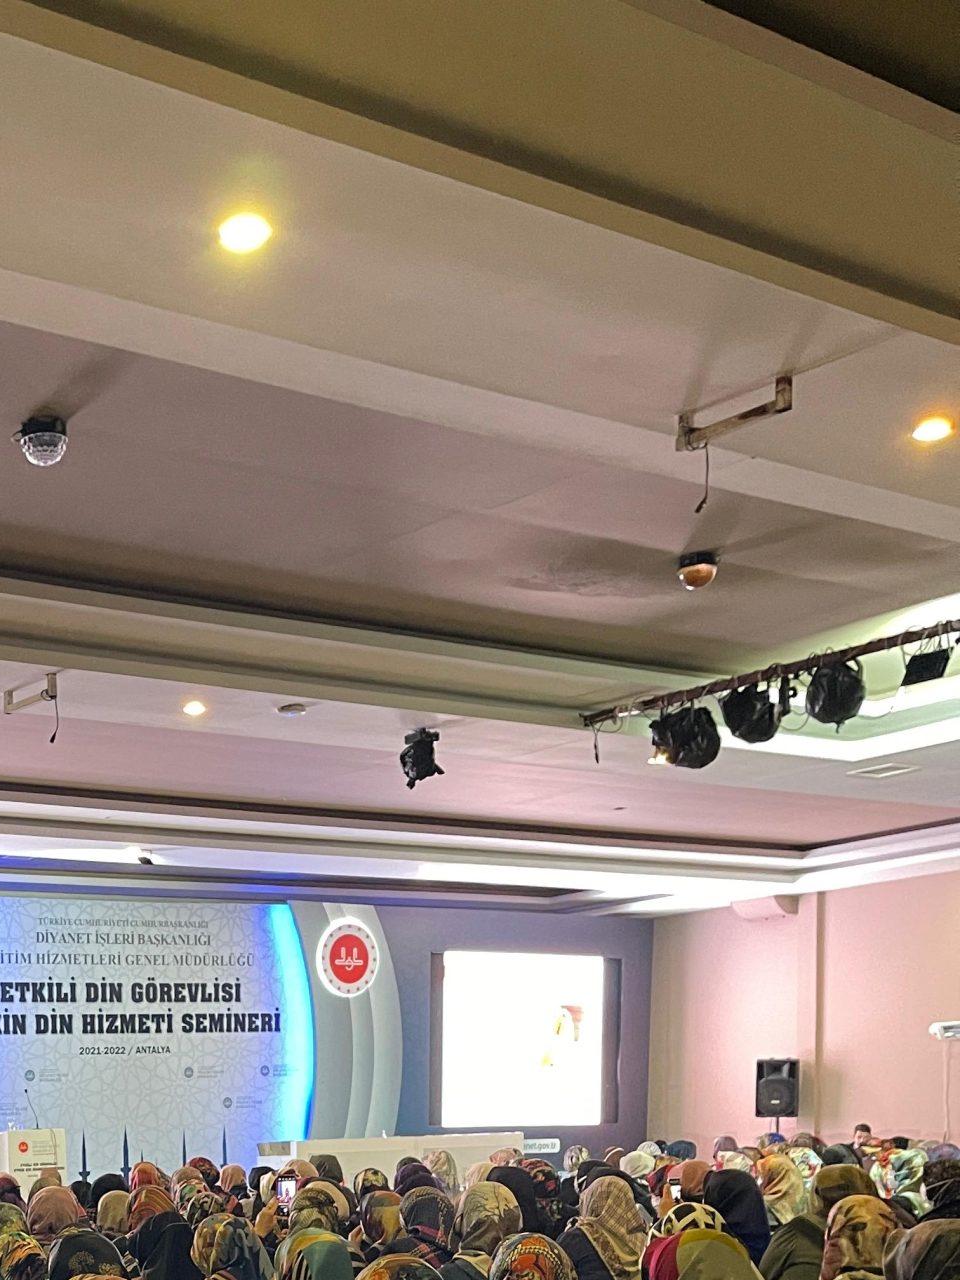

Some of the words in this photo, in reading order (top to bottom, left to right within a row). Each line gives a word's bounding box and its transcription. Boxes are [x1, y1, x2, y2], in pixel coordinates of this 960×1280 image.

[36, 931, 91, 944] DİYANET
[95, 931, 134, 947] İŞLERİ
[138, 932, 211, 947] BAŞKANLIĞI
[36, 950, 121, 966] HİZMETLERİ
[125, 954, 169, 967] GENEL
[173, 952, 254, 967] MÜDÜRLÜĞÜ
[0, 976, 77, 1003] ETKİLİ
[85, 976, 123, 1003] DİN
[131, 977, 241, 1003] GÖREVLİSİ
[35, 1008, 73, 1035] DİN
[82, 1008, 173, 1034] HİZMETİ
[181, 1007, 281, 1034] SEMİNERİ
[79, 1046, 126, 1056] 2021-2022
[135, 1045, 171, 1055] ANTALYA
